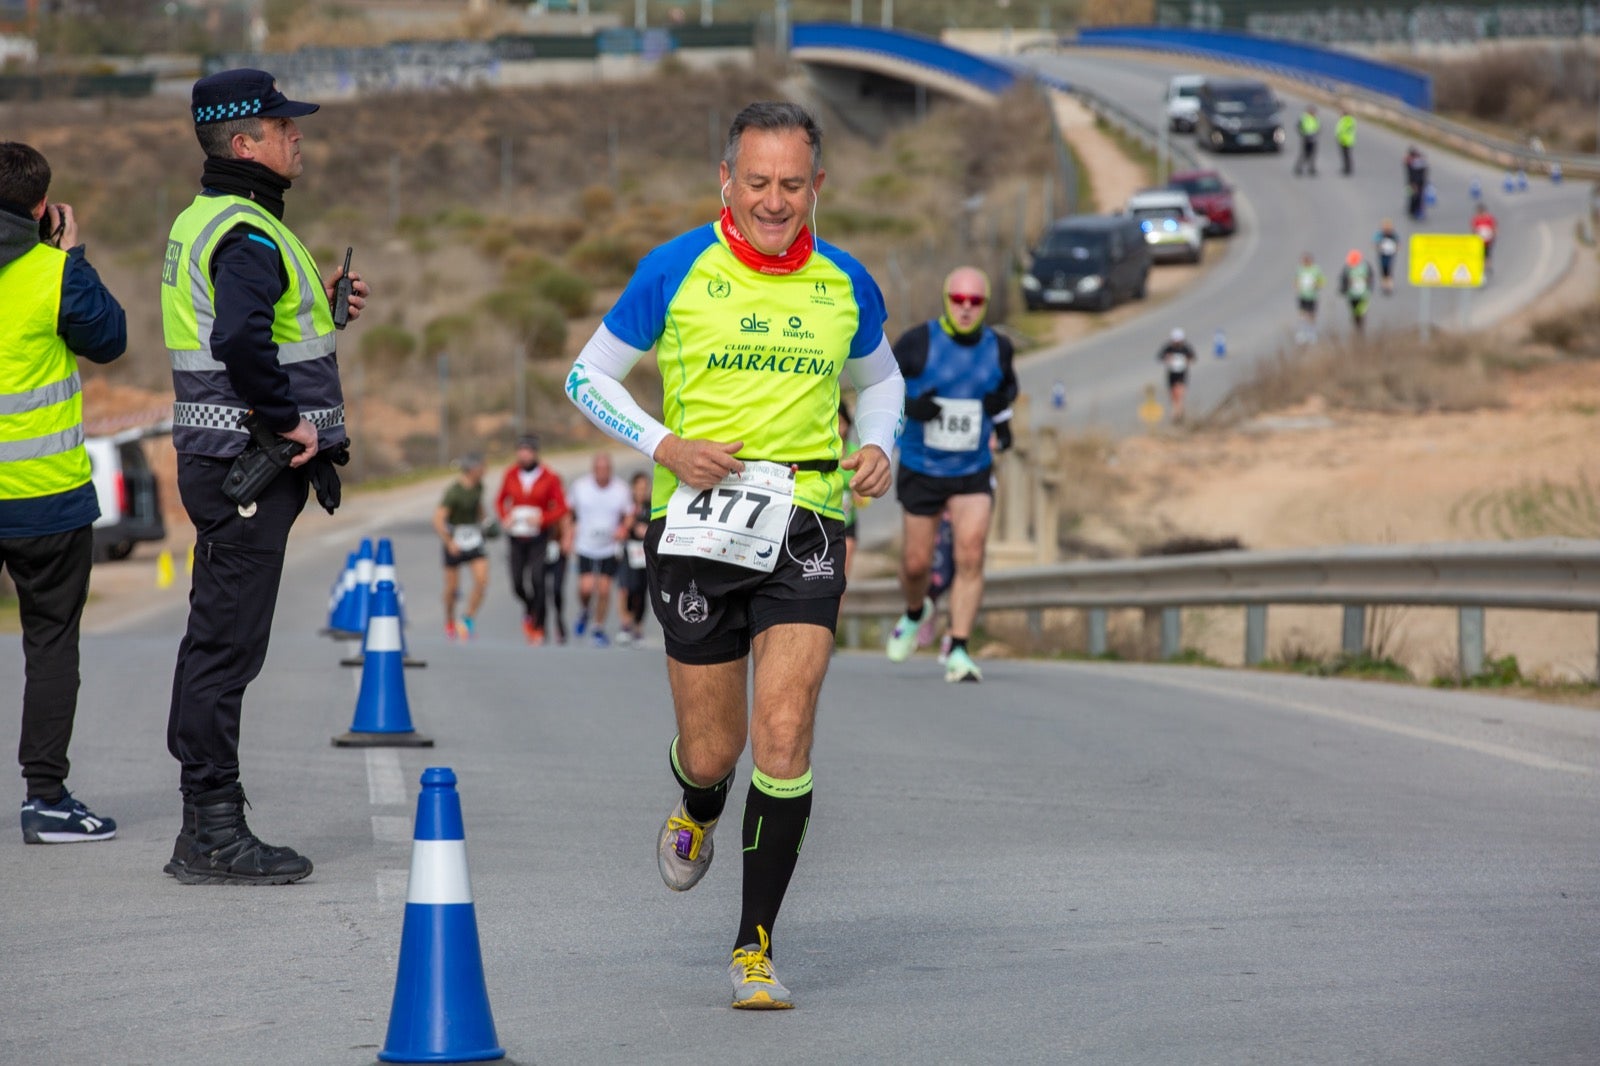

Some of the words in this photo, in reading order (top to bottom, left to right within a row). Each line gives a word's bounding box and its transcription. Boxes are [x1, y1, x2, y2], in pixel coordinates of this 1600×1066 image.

[740, 312, 770, 333] als
[724, 343, 751, 351] CLUB
[754, 344, 767, 352] DE
[769, 345, 824, 356] ATLETISMO
[706, 352, 835, 377] MARACENA
[581, 393, 640, 442] SALOBREÑA
[686, 488, 772, 529] 477
[802, 552, 835, 578] als
